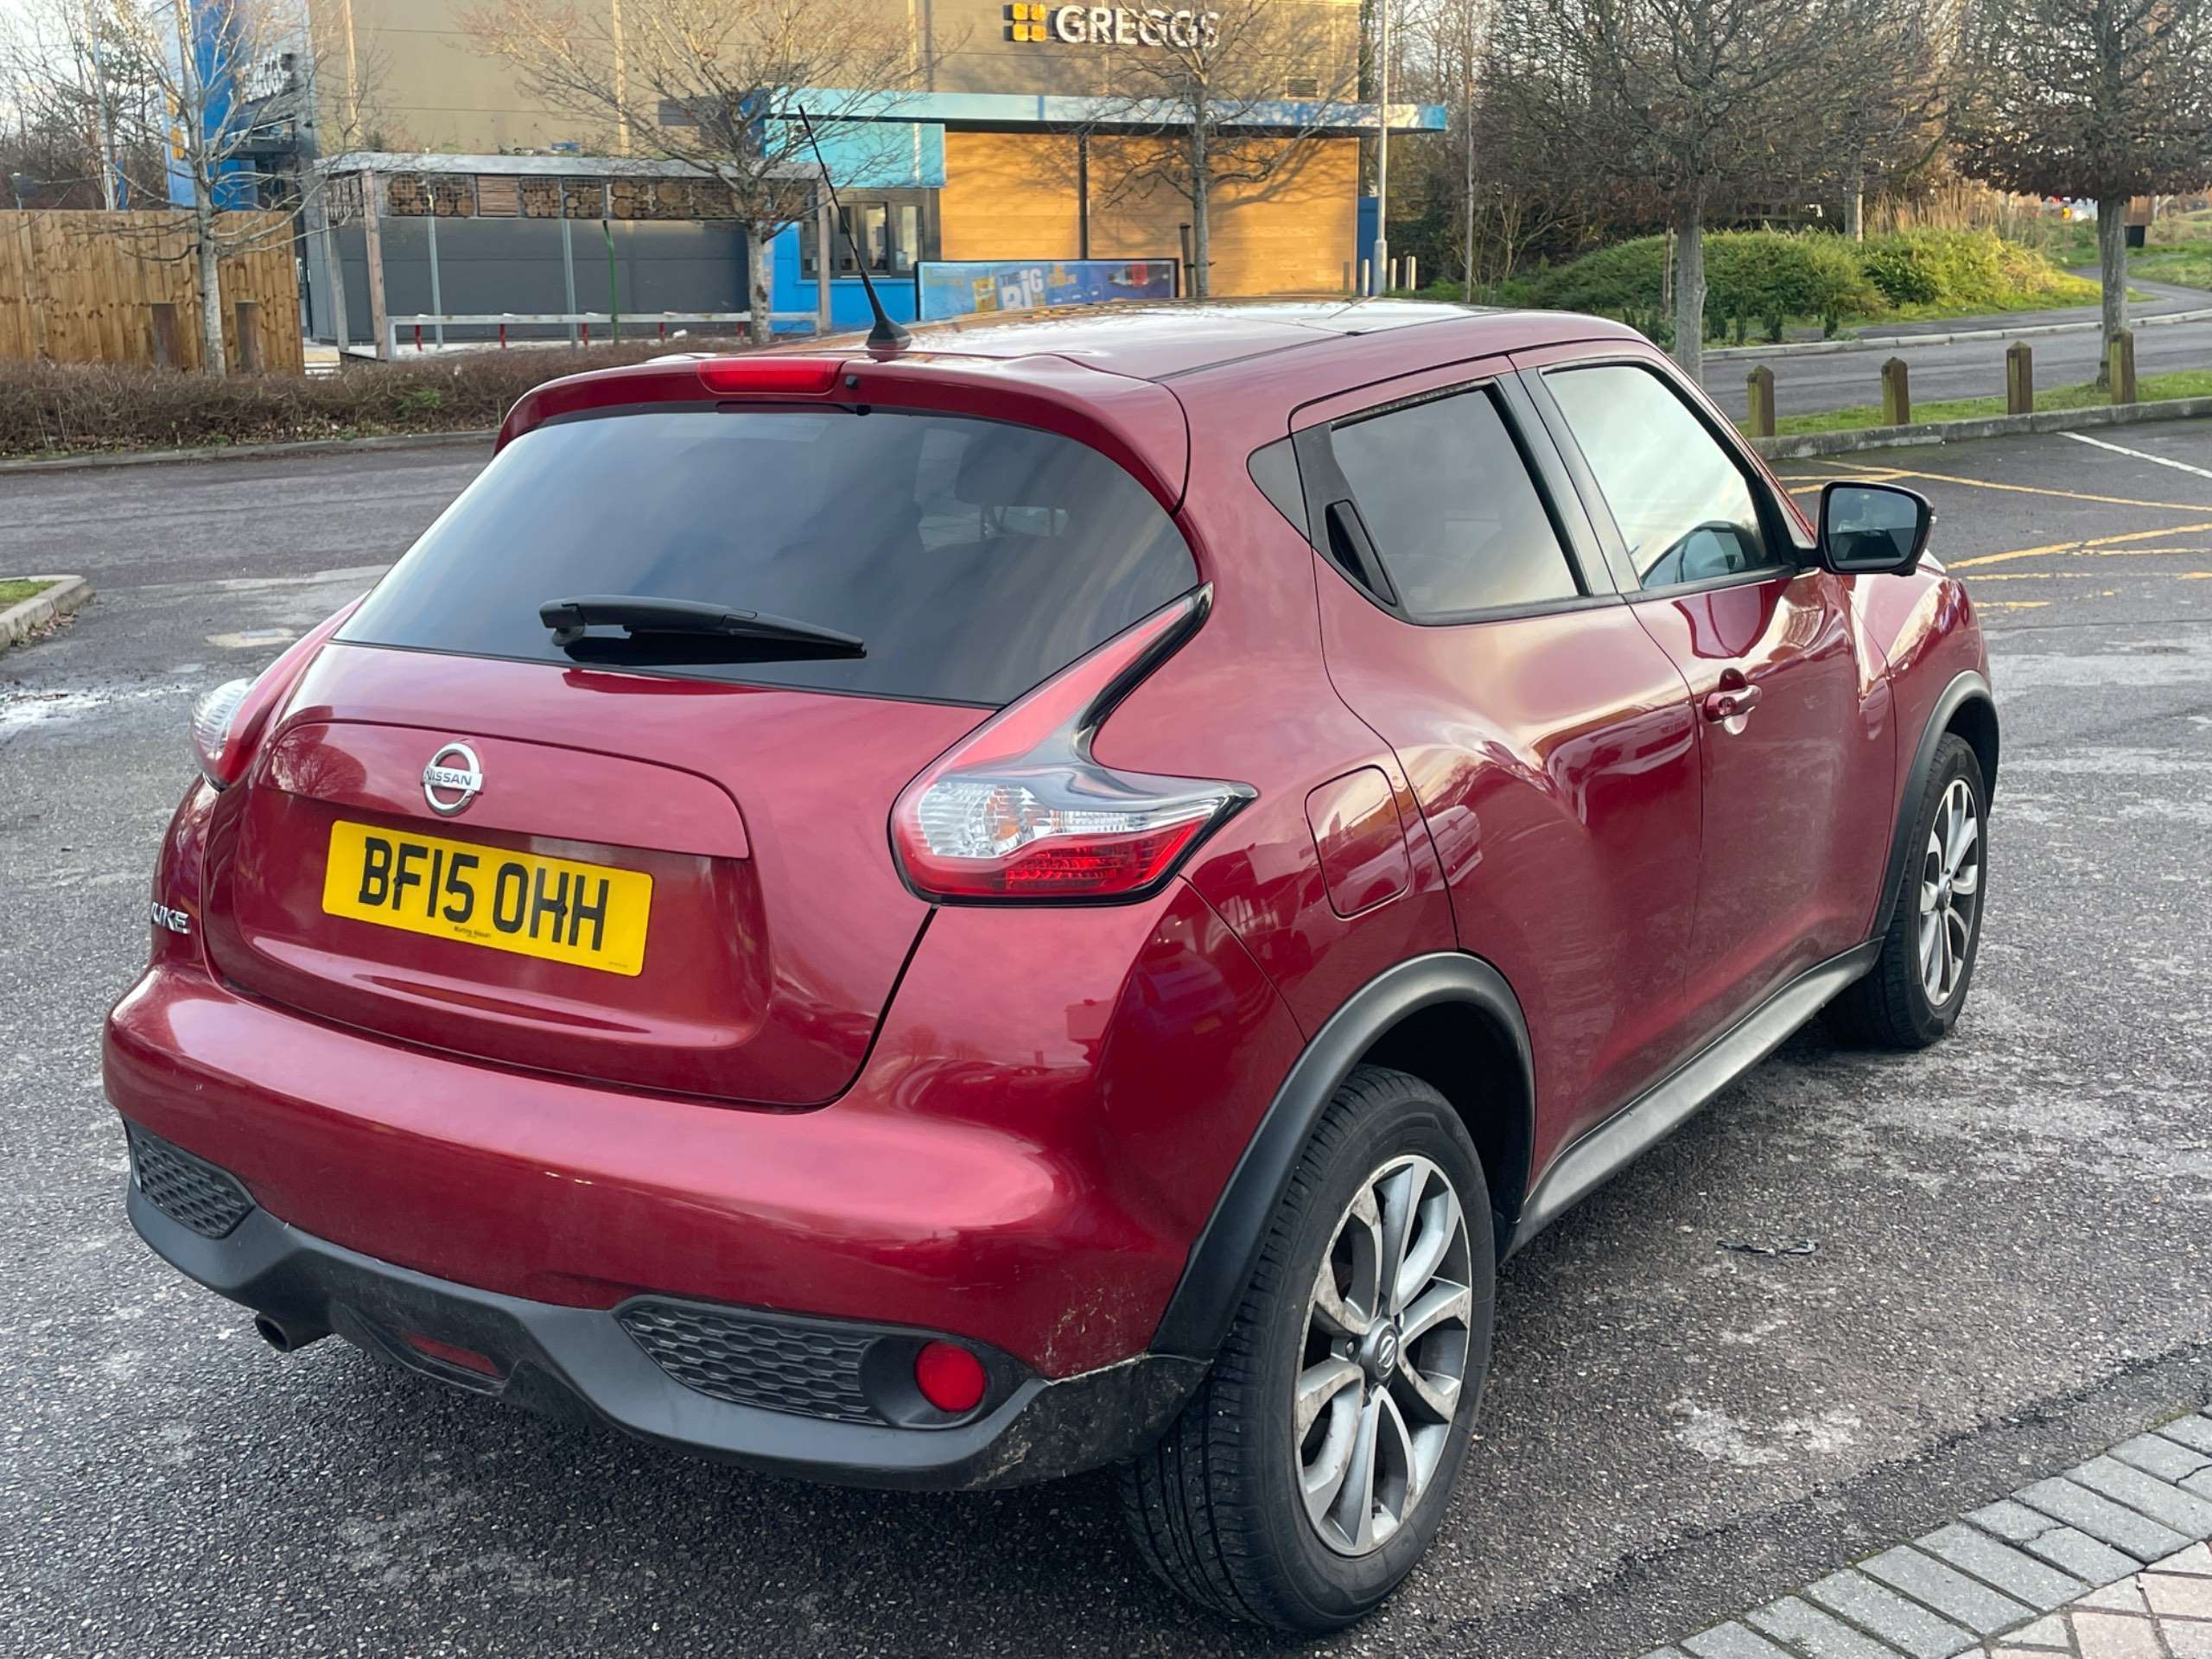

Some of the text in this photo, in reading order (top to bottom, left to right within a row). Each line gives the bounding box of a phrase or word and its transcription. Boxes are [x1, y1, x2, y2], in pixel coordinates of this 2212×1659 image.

[1056, 5, 1220, 48] GREGGS
[1001, 268, 1044, 308] BIG
[426, 770, 472, 786] NISSAN
[358, 836, 610, 951] BF15 OHH
